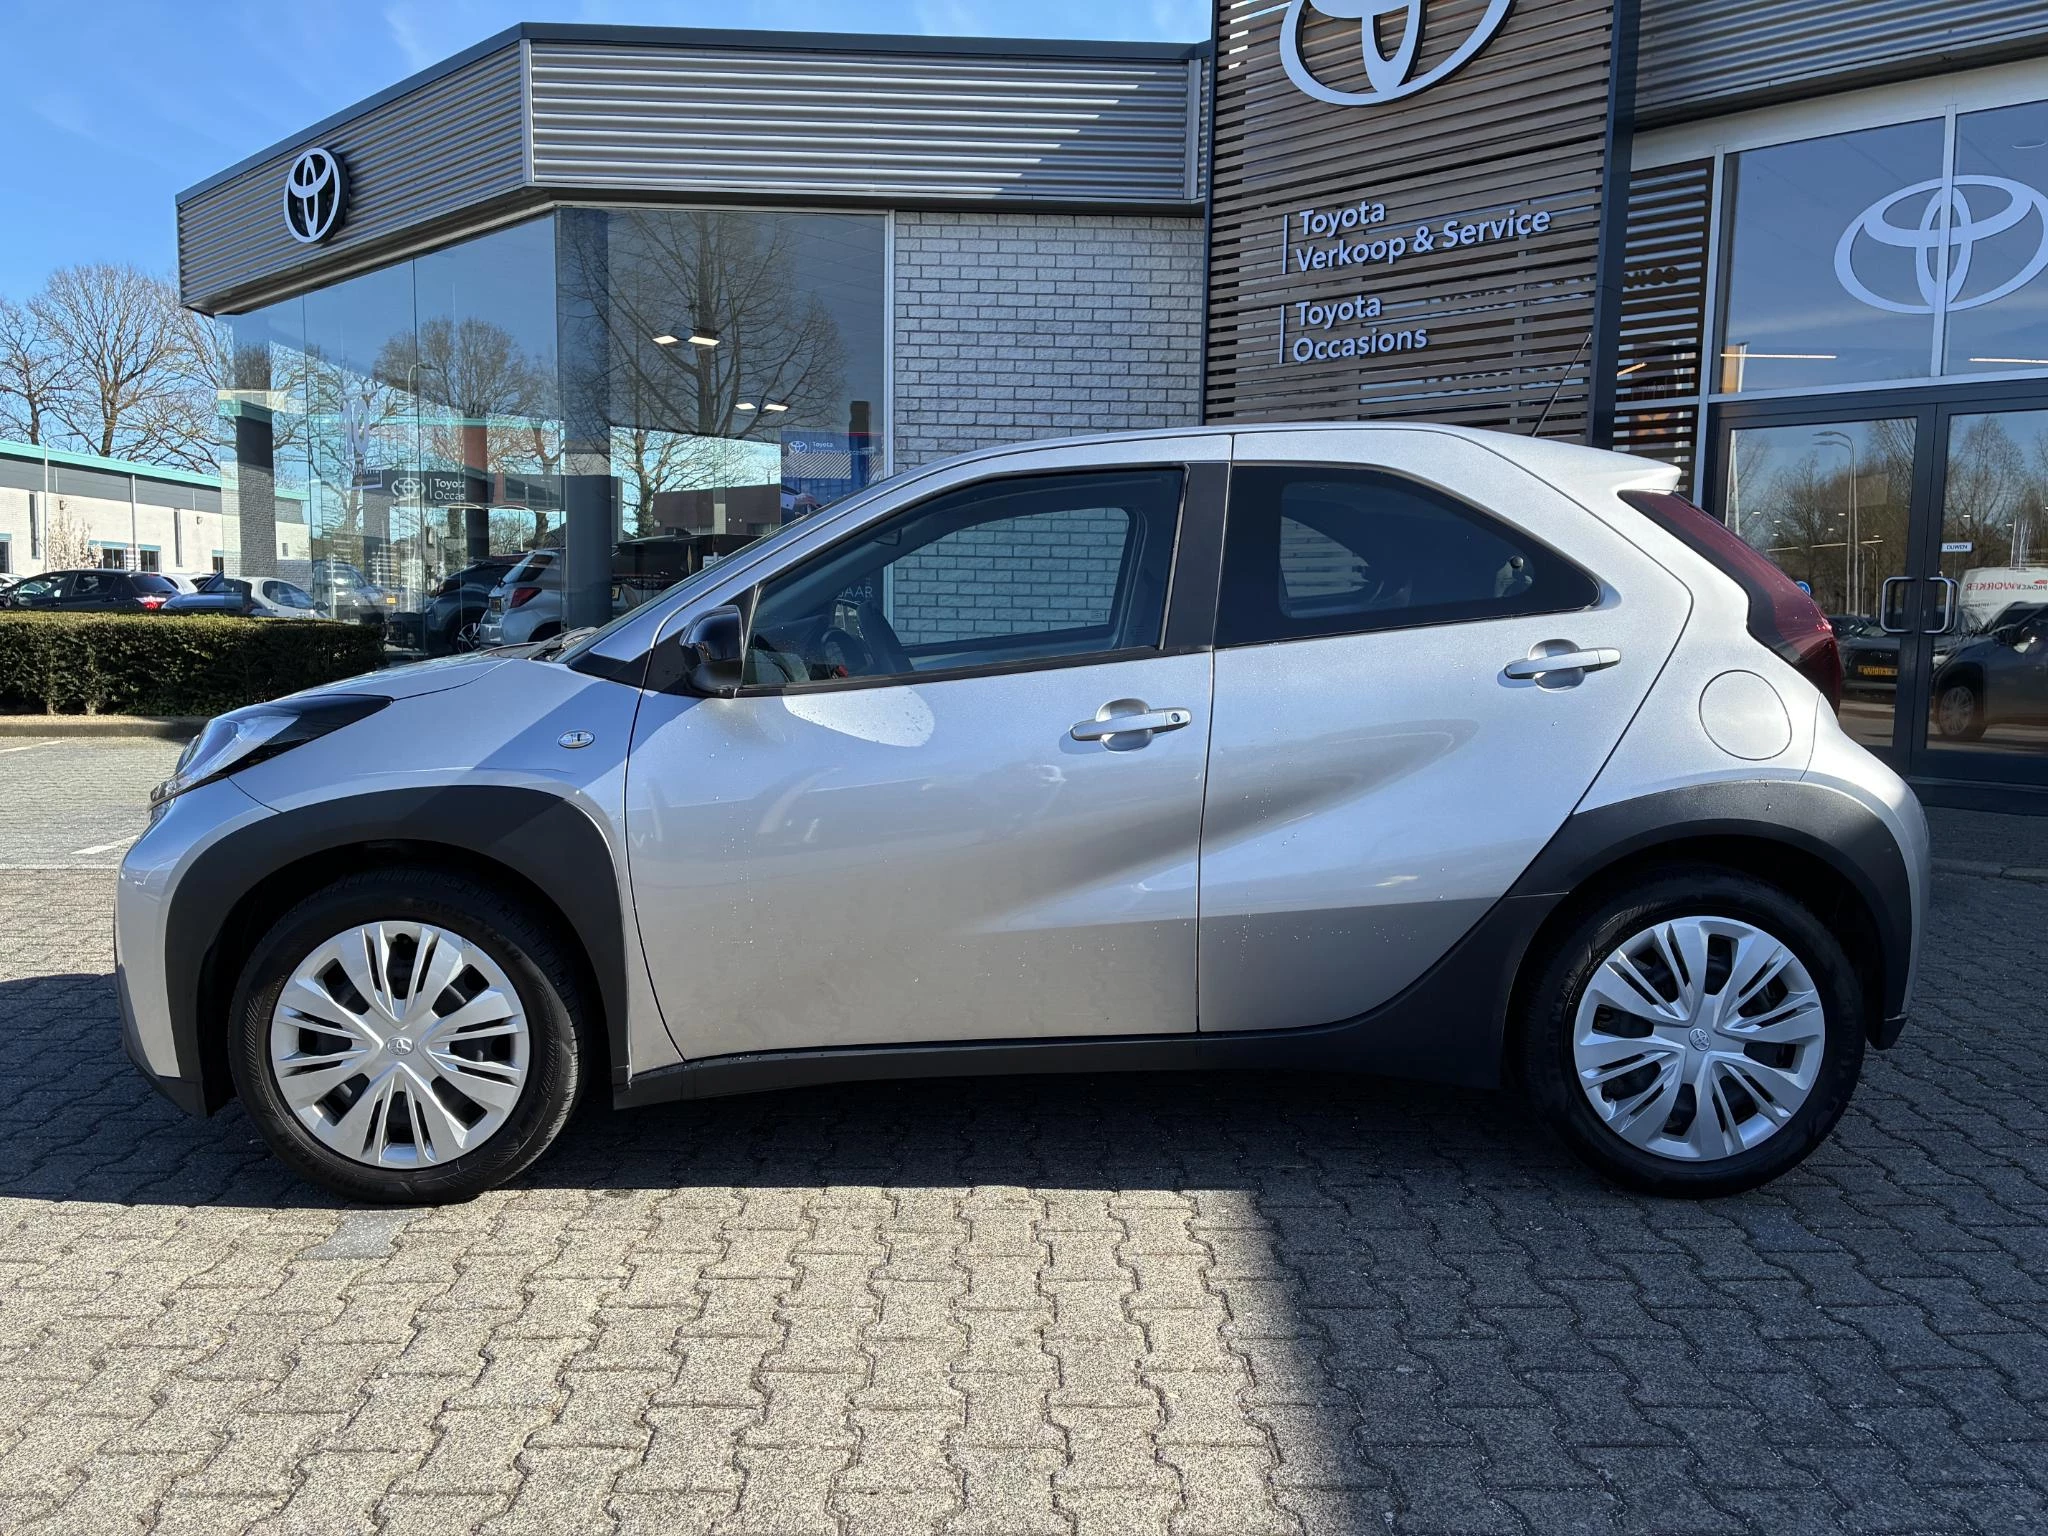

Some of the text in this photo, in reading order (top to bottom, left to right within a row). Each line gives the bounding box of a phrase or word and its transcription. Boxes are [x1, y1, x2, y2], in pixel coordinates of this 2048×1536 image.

[1299, 200, 1386, 238] Toyota
[1295, 208, 1551, 272] Verkoop & Service
[1295, 294, 1382, 330] Toyota
[1292, 327, 1428, 362] Occasions
